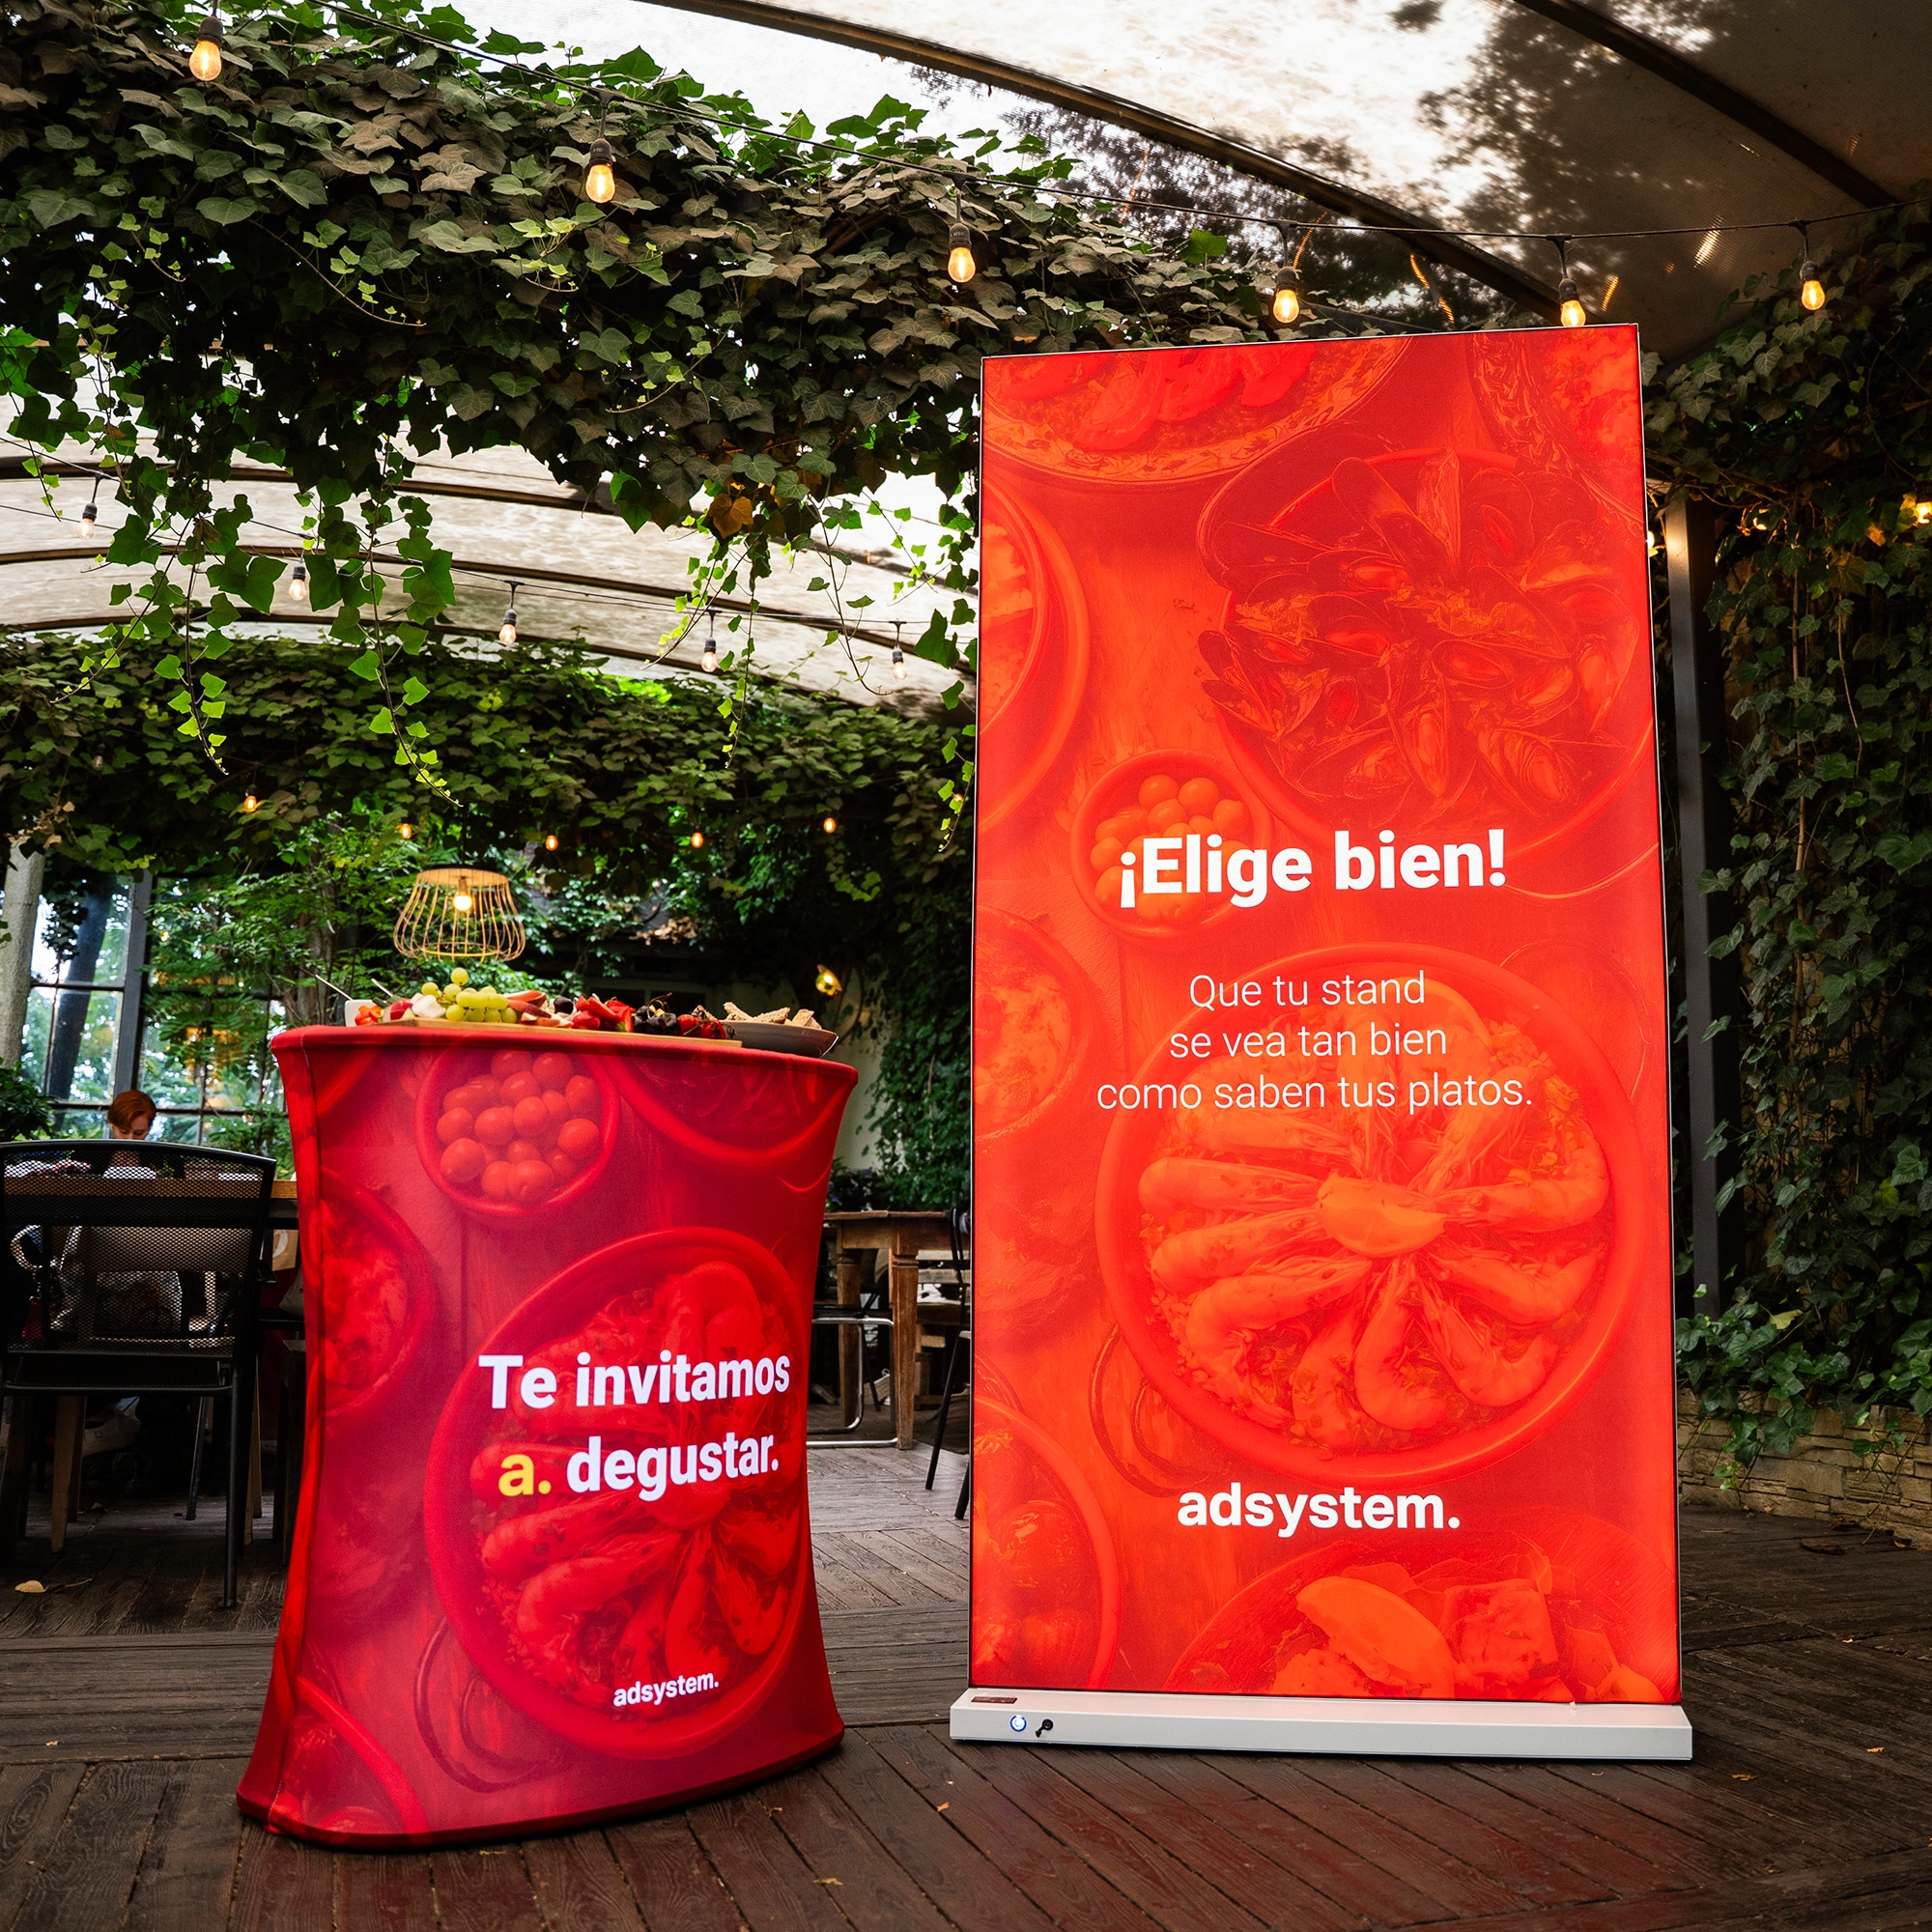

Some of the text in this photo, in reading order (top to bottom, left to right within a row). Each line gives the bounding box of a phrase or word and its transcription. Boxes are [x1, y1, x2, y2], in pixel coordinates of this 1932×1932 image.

[1120, 828, 1506, 909] ¡Elige bien!
[1189, 969, 1426, 1011] Que tu stand
[1170, 1021, 1447, 1059] se vea tan bien
[1096, 1071, 1533, 1116] como saben tus platos.
[478, 1350, 790, 1409] Te invitamos
[497, 1432, 779, 1502] a. degustar.
[1178, 1482, 1461, 1538] adsystem.
[613, 1672, 720, 1707] adsystem.
